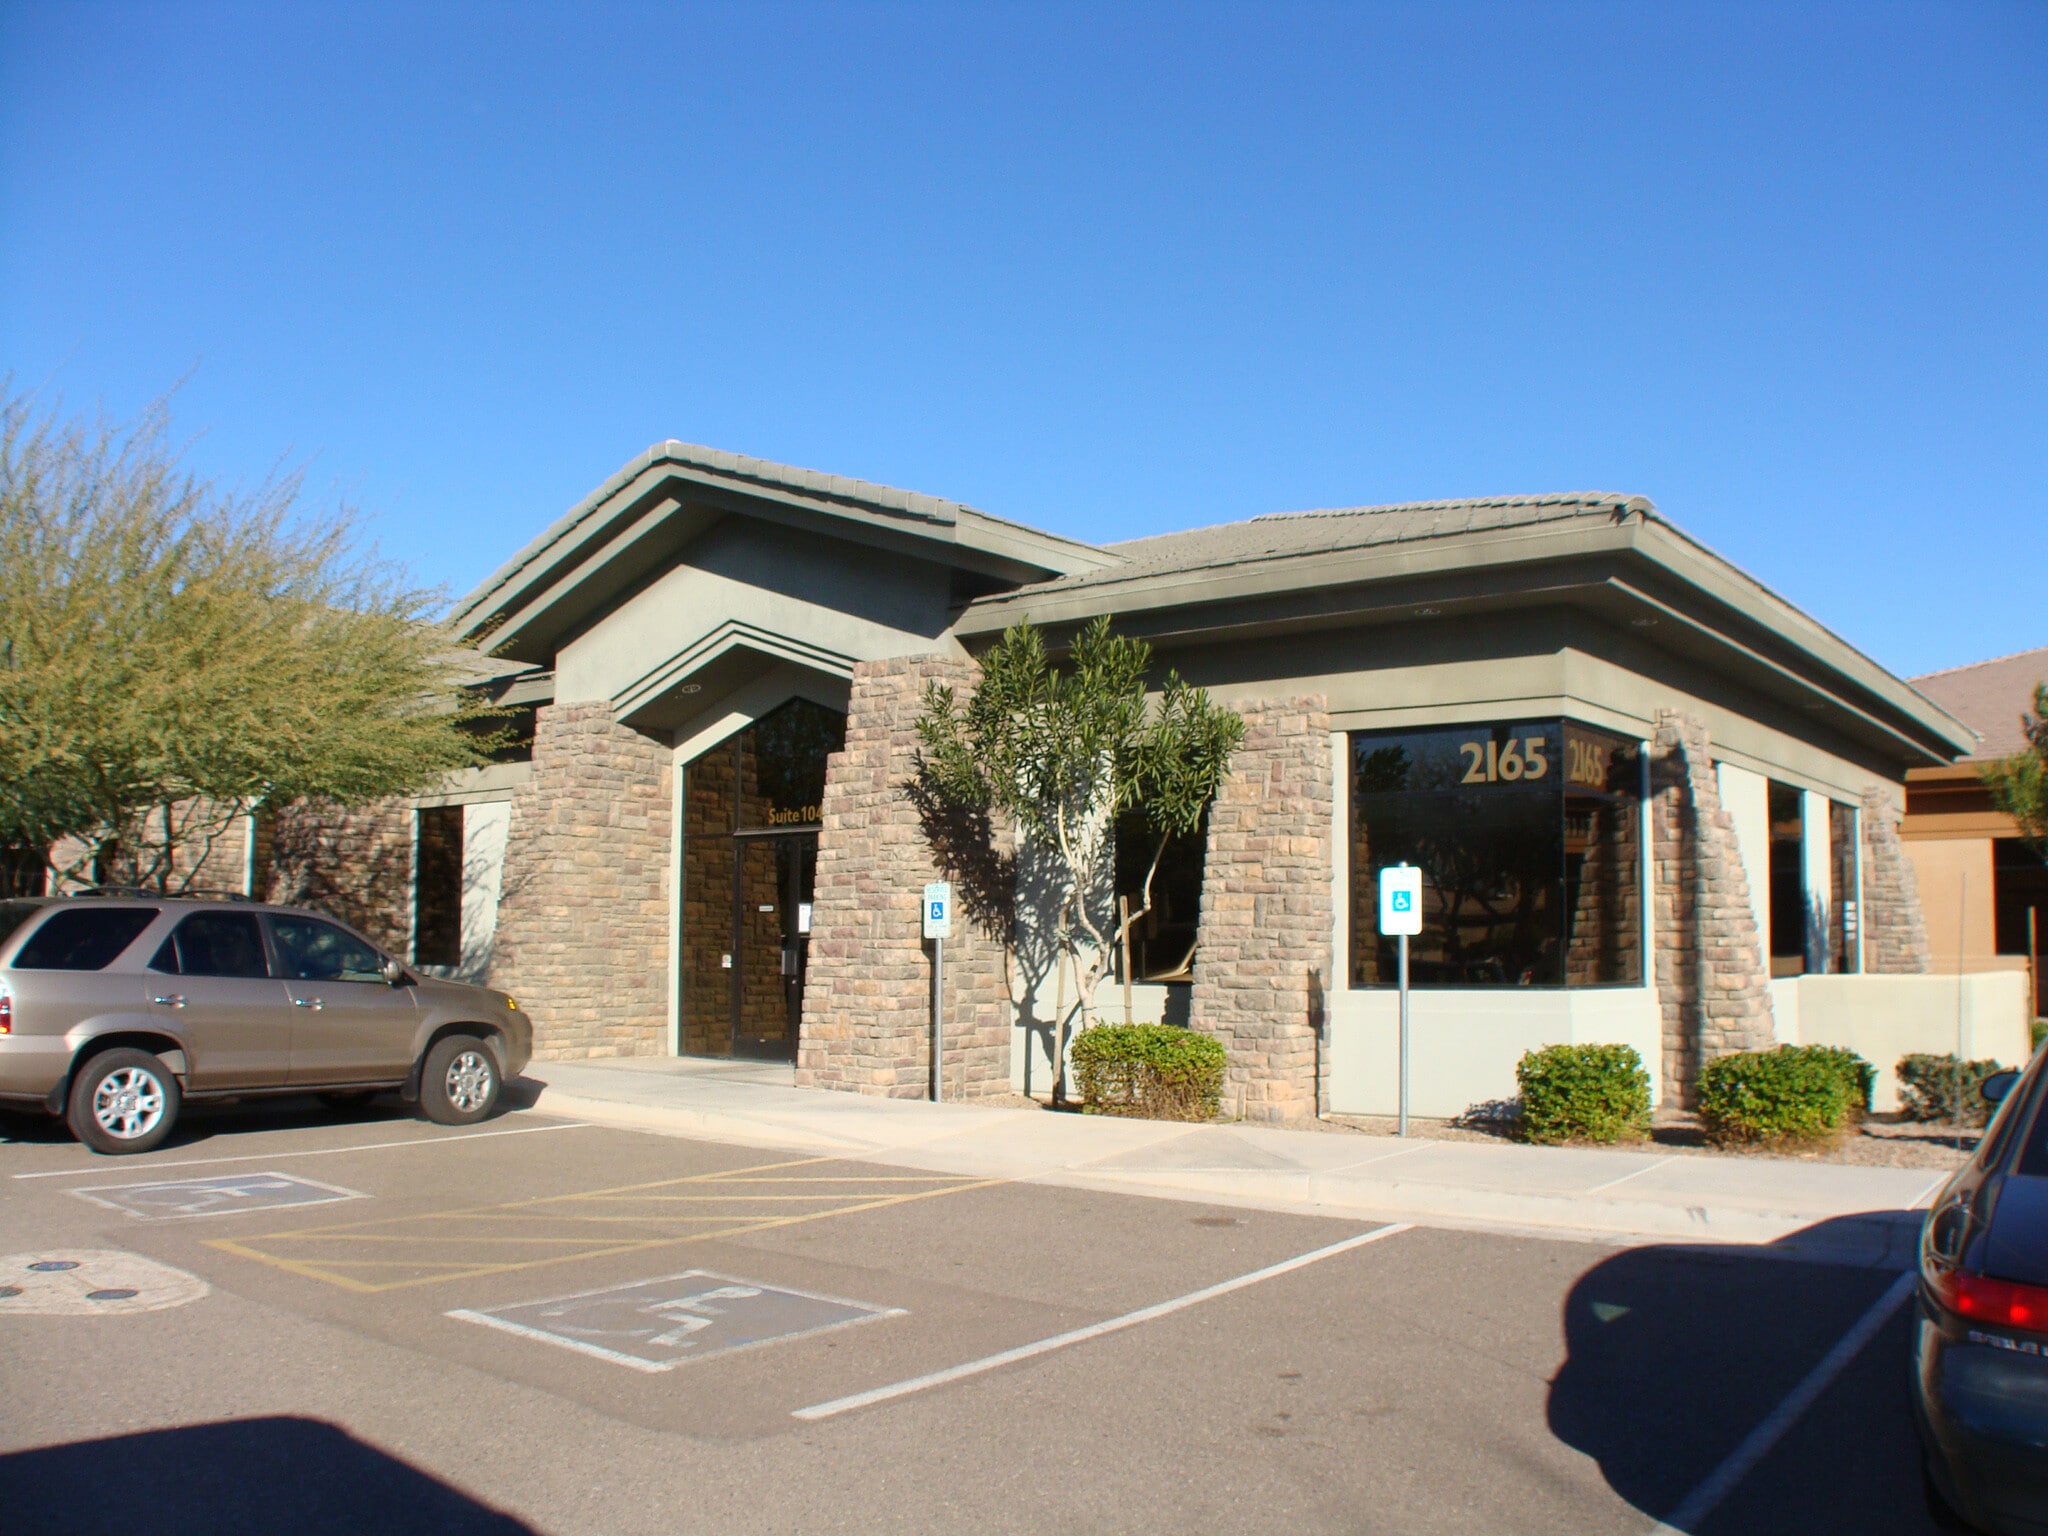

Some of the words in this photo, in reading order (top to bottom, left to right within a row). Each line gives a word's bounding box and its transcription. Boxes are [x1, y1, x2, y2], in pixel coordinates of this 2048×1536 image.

[1459, 737, 1548, 783] 2165
[1569, 738, 1606, 786] 2165
[768, 807, 800, 824] Suite
